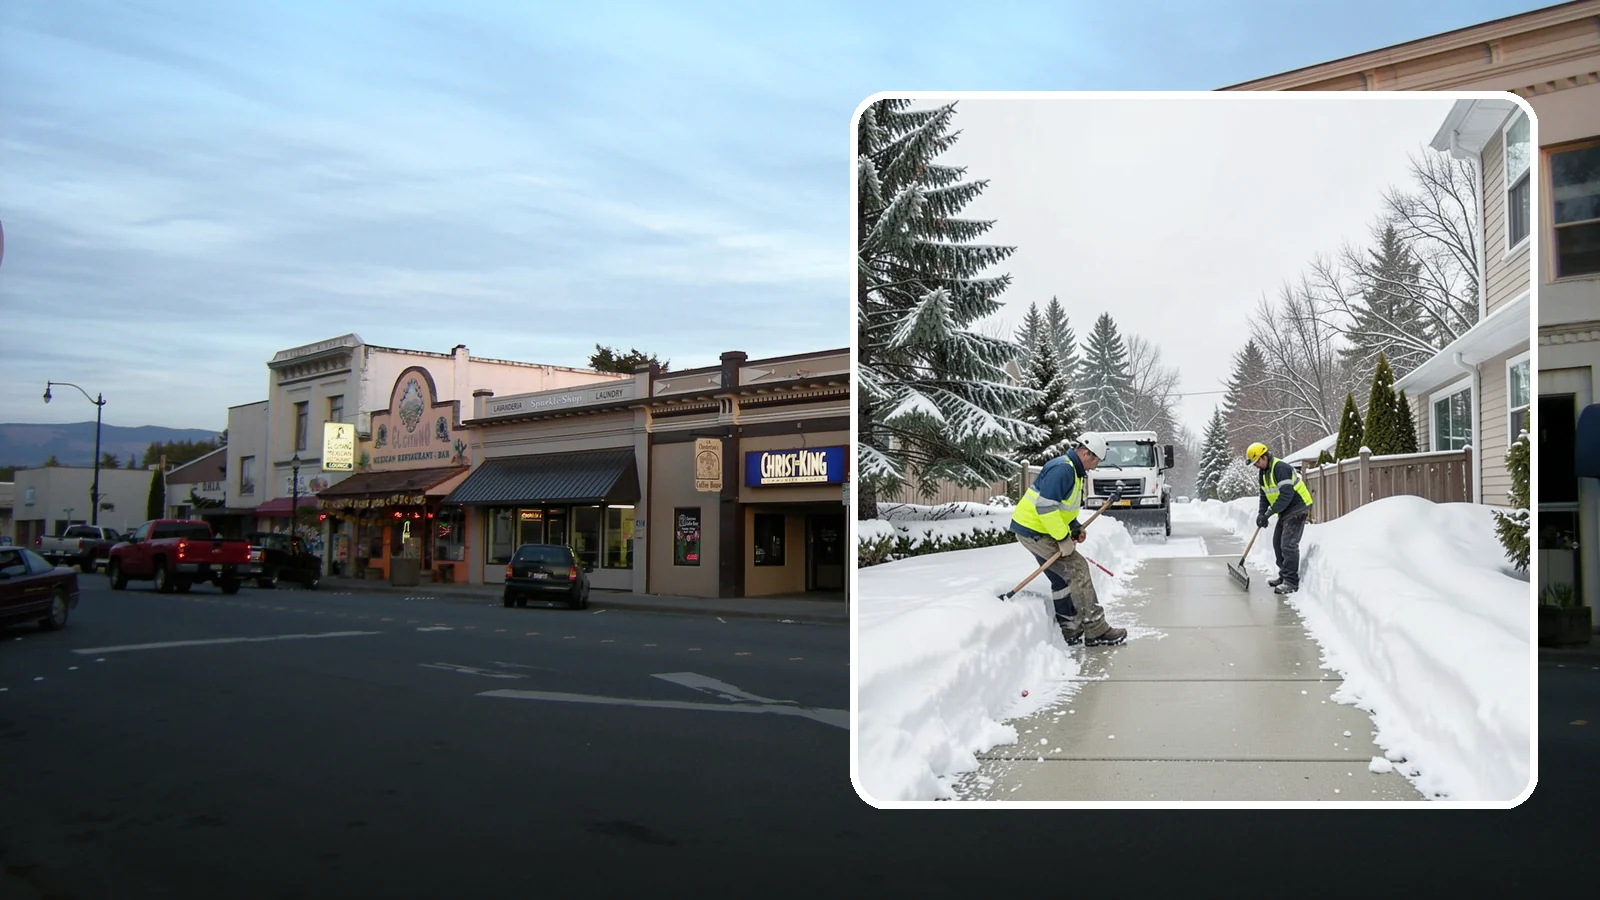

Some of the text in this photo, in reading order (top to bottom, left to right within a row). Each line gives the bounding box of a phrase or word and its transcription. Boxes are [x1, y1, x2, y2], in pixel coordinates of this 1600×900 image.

[595, 389, 624, 400] LAUNDRY
[530, 394, 582, 408] Sparkle Shop
[493, 402, 523, 413] LAVANDERIA
[373, 455, 396, 464] MEXICAN
[397, 451, 433, 462] RESTAURANT
[438, 450, 450, 459] BAR
[761, 450, 827, 478] CHRIST KING
[696, 481, 709, 489] Coffee
